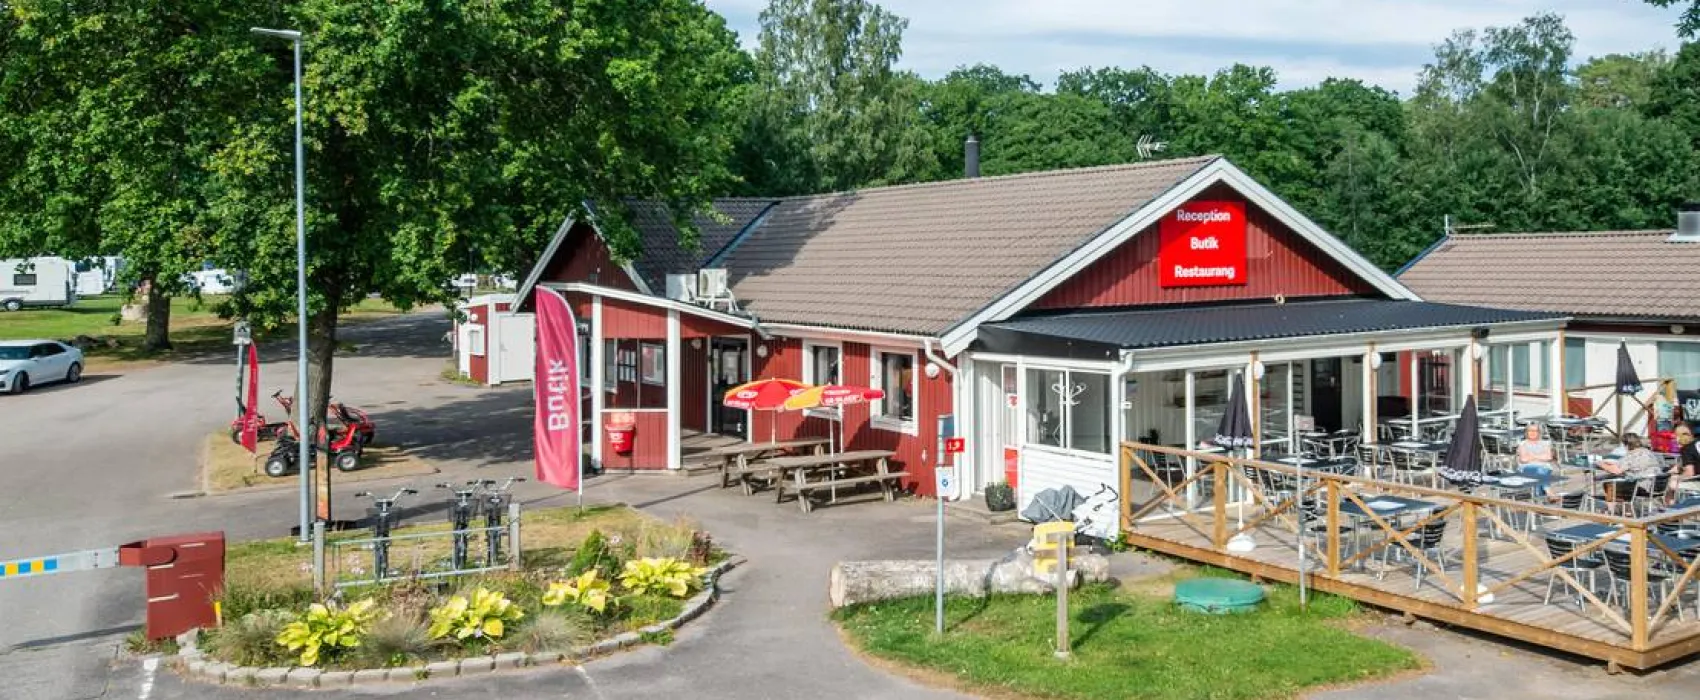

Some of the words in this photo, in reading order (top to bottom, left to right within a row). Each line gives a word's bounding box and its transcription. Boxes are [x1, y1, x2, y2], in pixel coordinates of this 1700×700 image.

[1177, 209, 1230, 224] Reception
[1190, 236, 1218, 249] Butik
[1175, 265, 1234, 279] Restaurang
[547, 359, 570, 430] Butik
